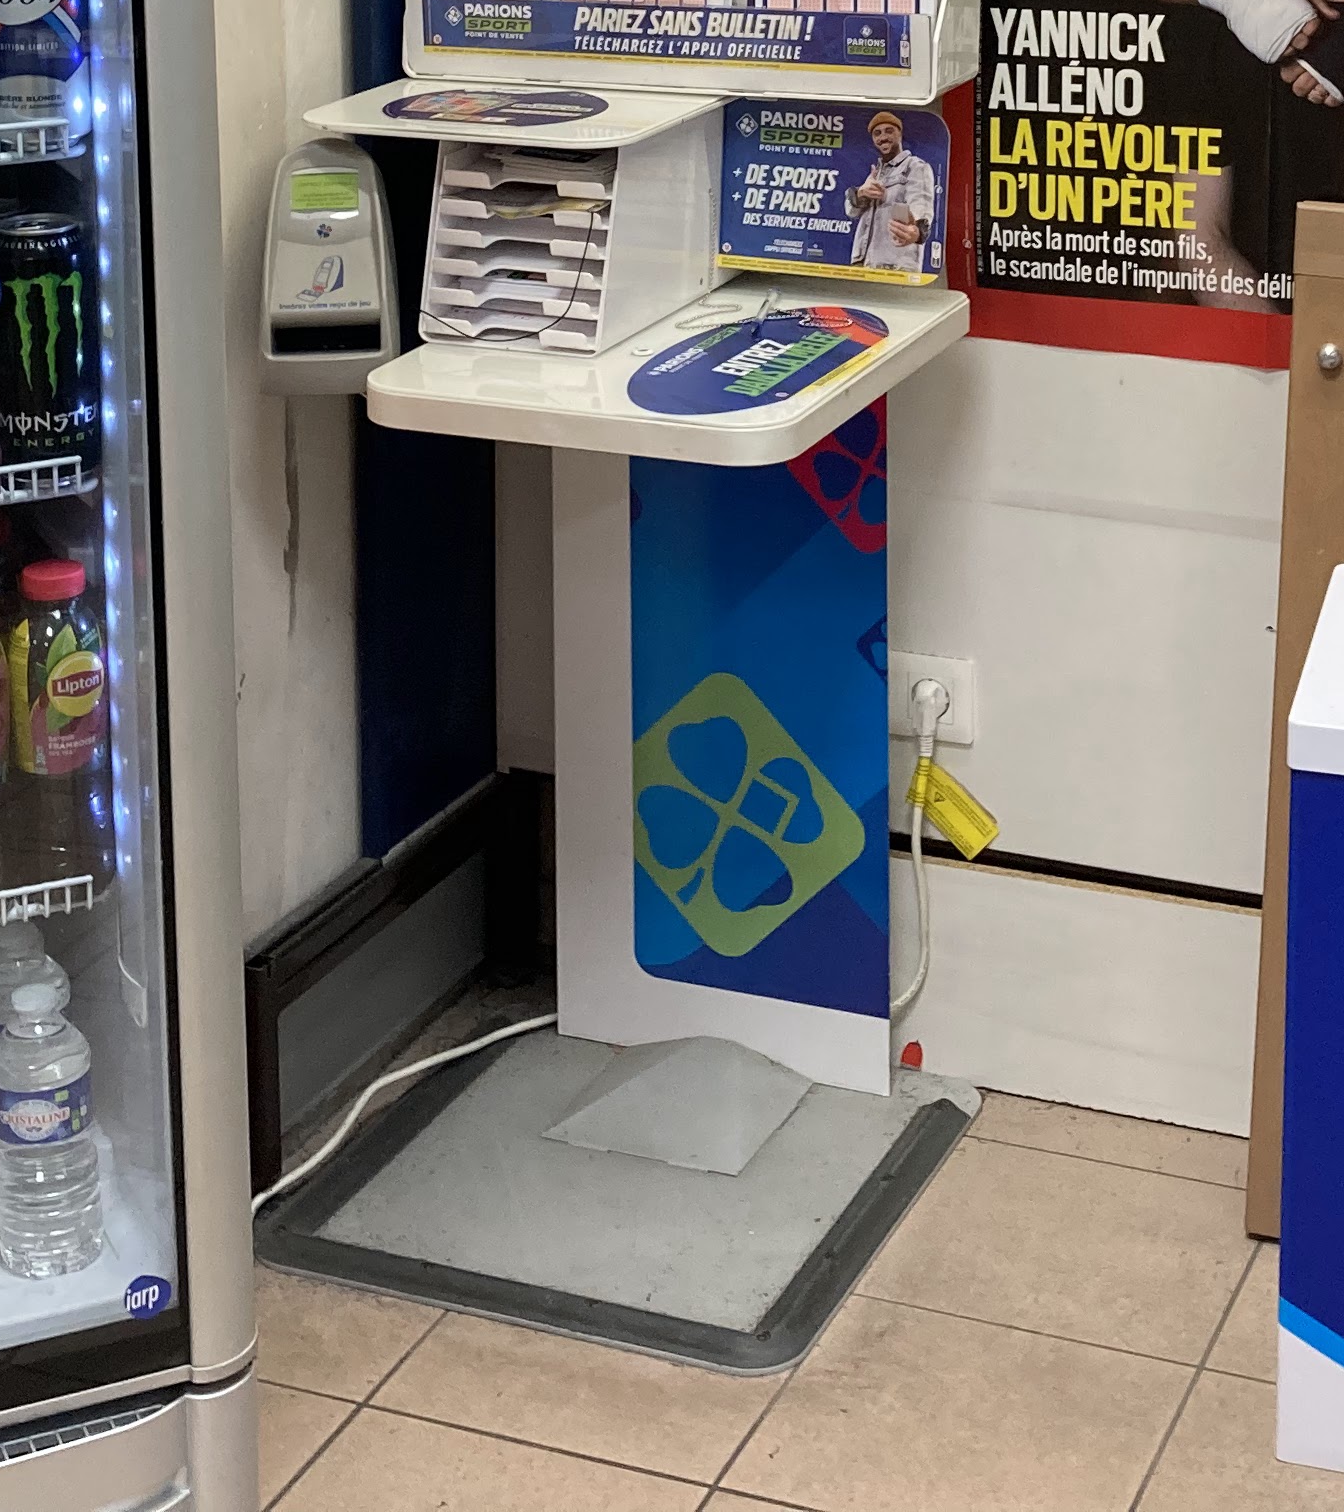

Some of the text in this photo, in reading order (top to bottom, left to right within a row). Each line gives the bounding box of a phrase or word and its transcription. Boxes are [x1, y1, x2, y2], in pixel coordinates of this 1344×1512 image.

[574, 6, 802, 42] PARIEZ SANS BULLETIN
[989, 7, 1166, 63] YANNICK
[574, 34, 803, 60] TÉLÉCHARGEZ L'APPLI OFFICIELLE
[989, 60, 1144, 117] ALLÉNO
[742, 212, 853, 234] DES SERVICES ENRICHIS
[990, 222, 1213, 264] Après la mort de son fils,
[14, 428, 95, 449] ENERGY
[0, 1107, 70, 1129] CRISTALINE
[126, 1286, 159, 1312] iarp
